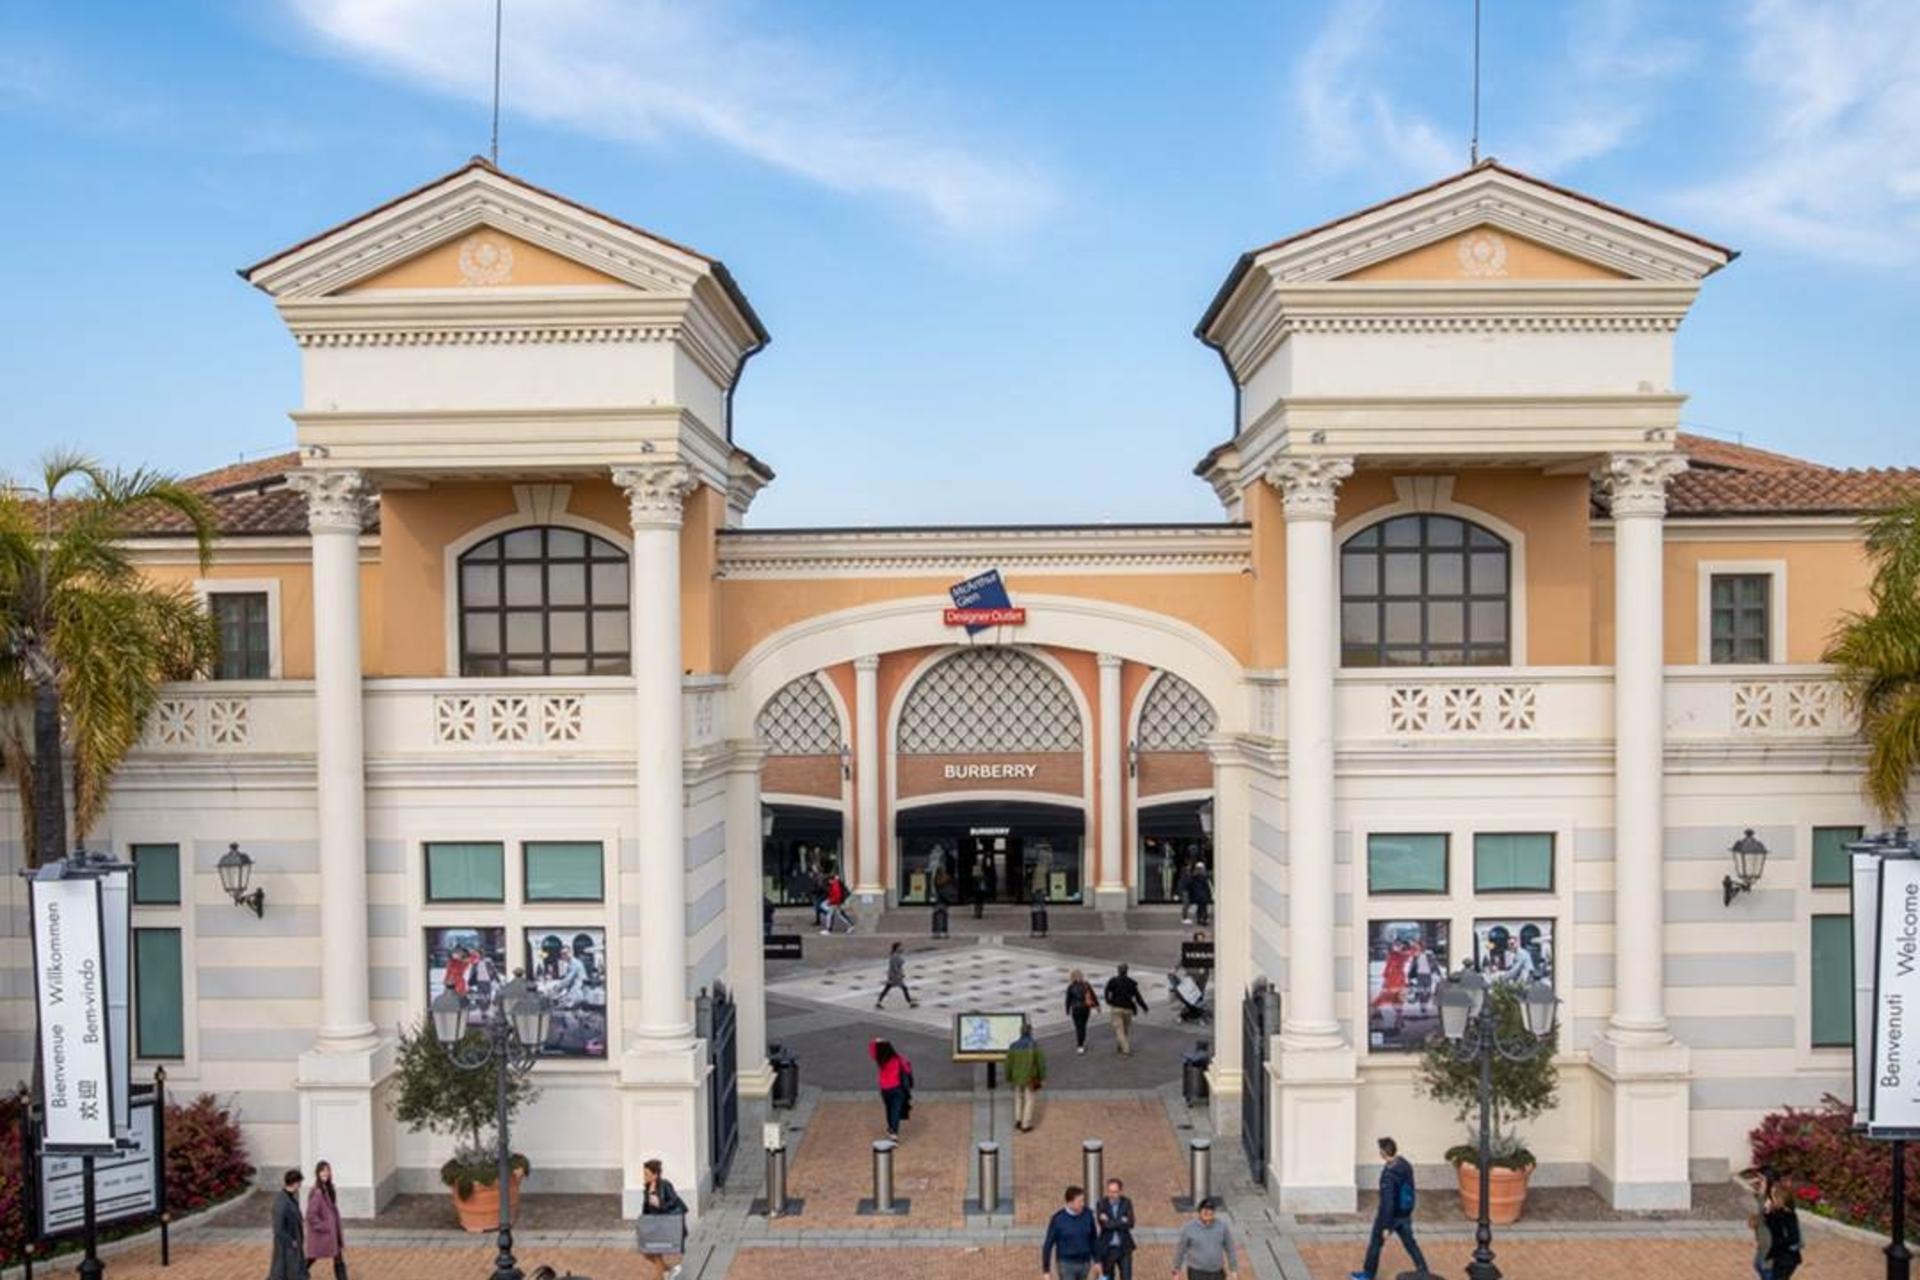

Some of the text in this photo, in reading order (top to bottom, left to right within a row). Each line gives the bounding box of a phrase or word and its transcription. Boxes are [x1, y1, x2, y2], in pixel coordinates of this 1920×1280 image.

[944, 763, 1037, 778] BURBERRY
[1896, 883, 1919, 977] Welcome
[47, 902, 67, 1108] Bienvenue Willkommen
[78, 959, 99, 1044] Bem-vindo
[1881, 995, 1902, 1087] Benvenuti
[78, 1080, 99, 1120] 欢迎
